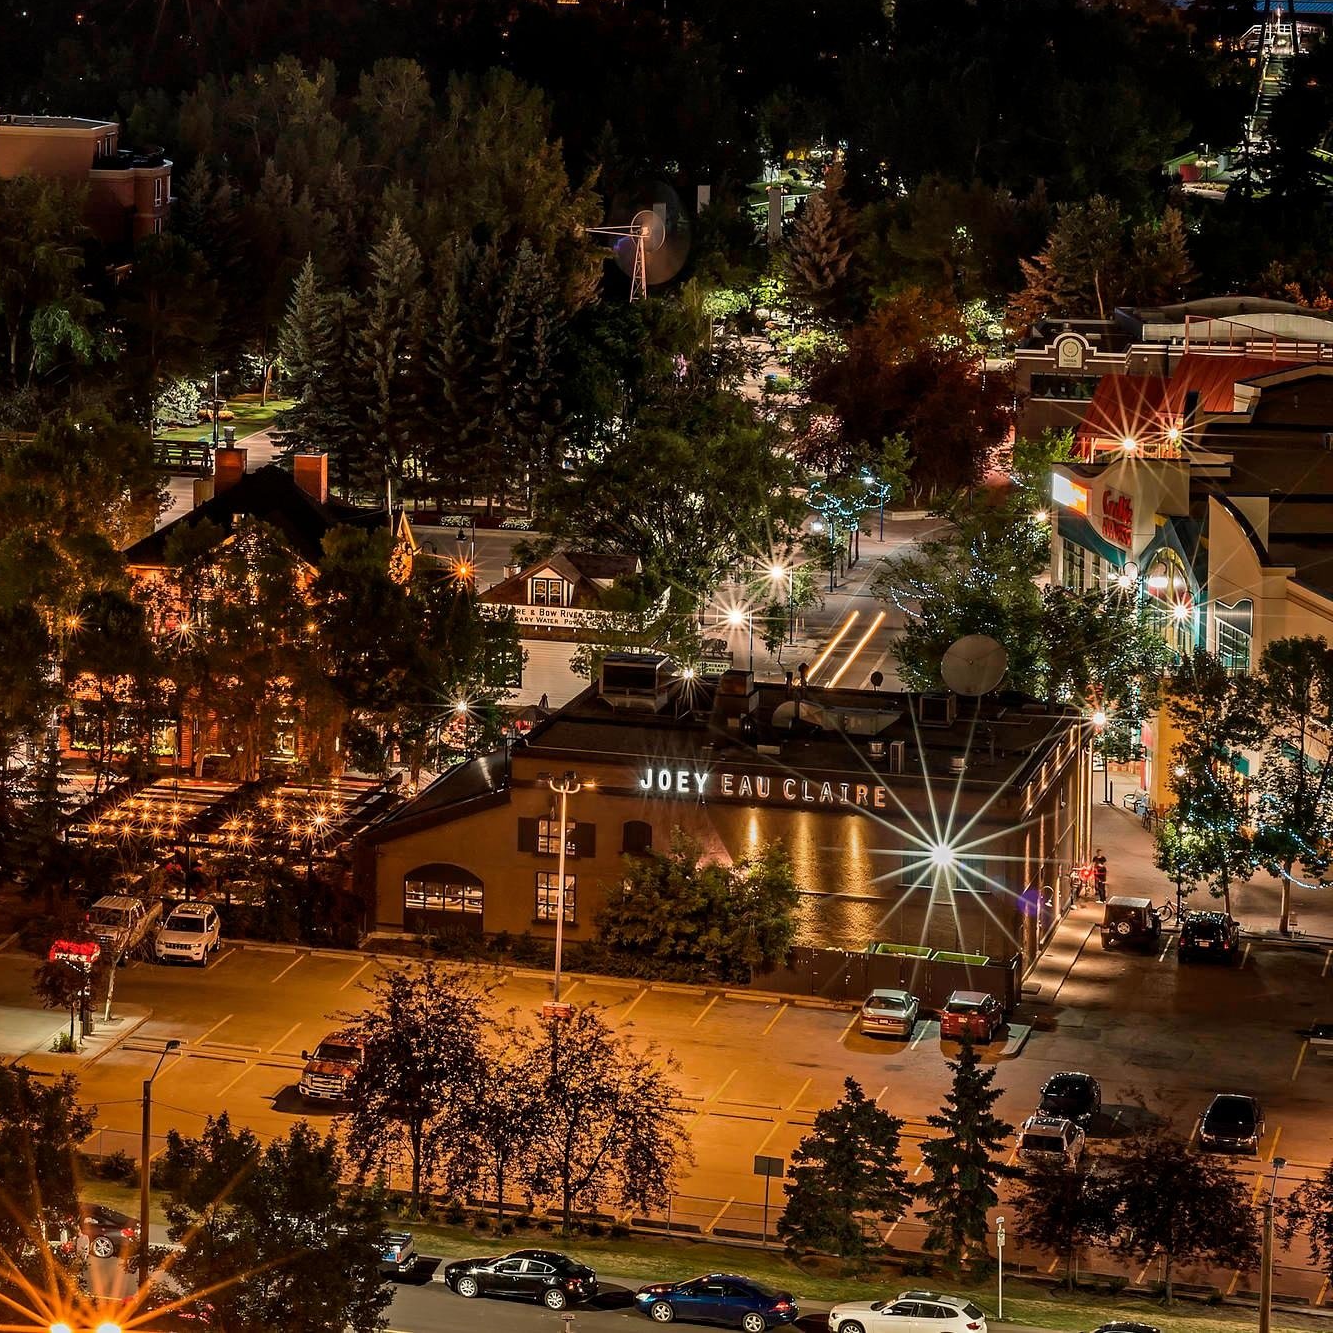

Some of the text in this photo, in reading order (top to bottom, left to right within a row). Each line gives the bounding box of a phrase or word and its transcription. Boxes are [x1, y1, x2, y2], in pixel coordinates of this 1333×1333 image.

[640, 767, 887, 809] JOEY EAU CLAIRE
